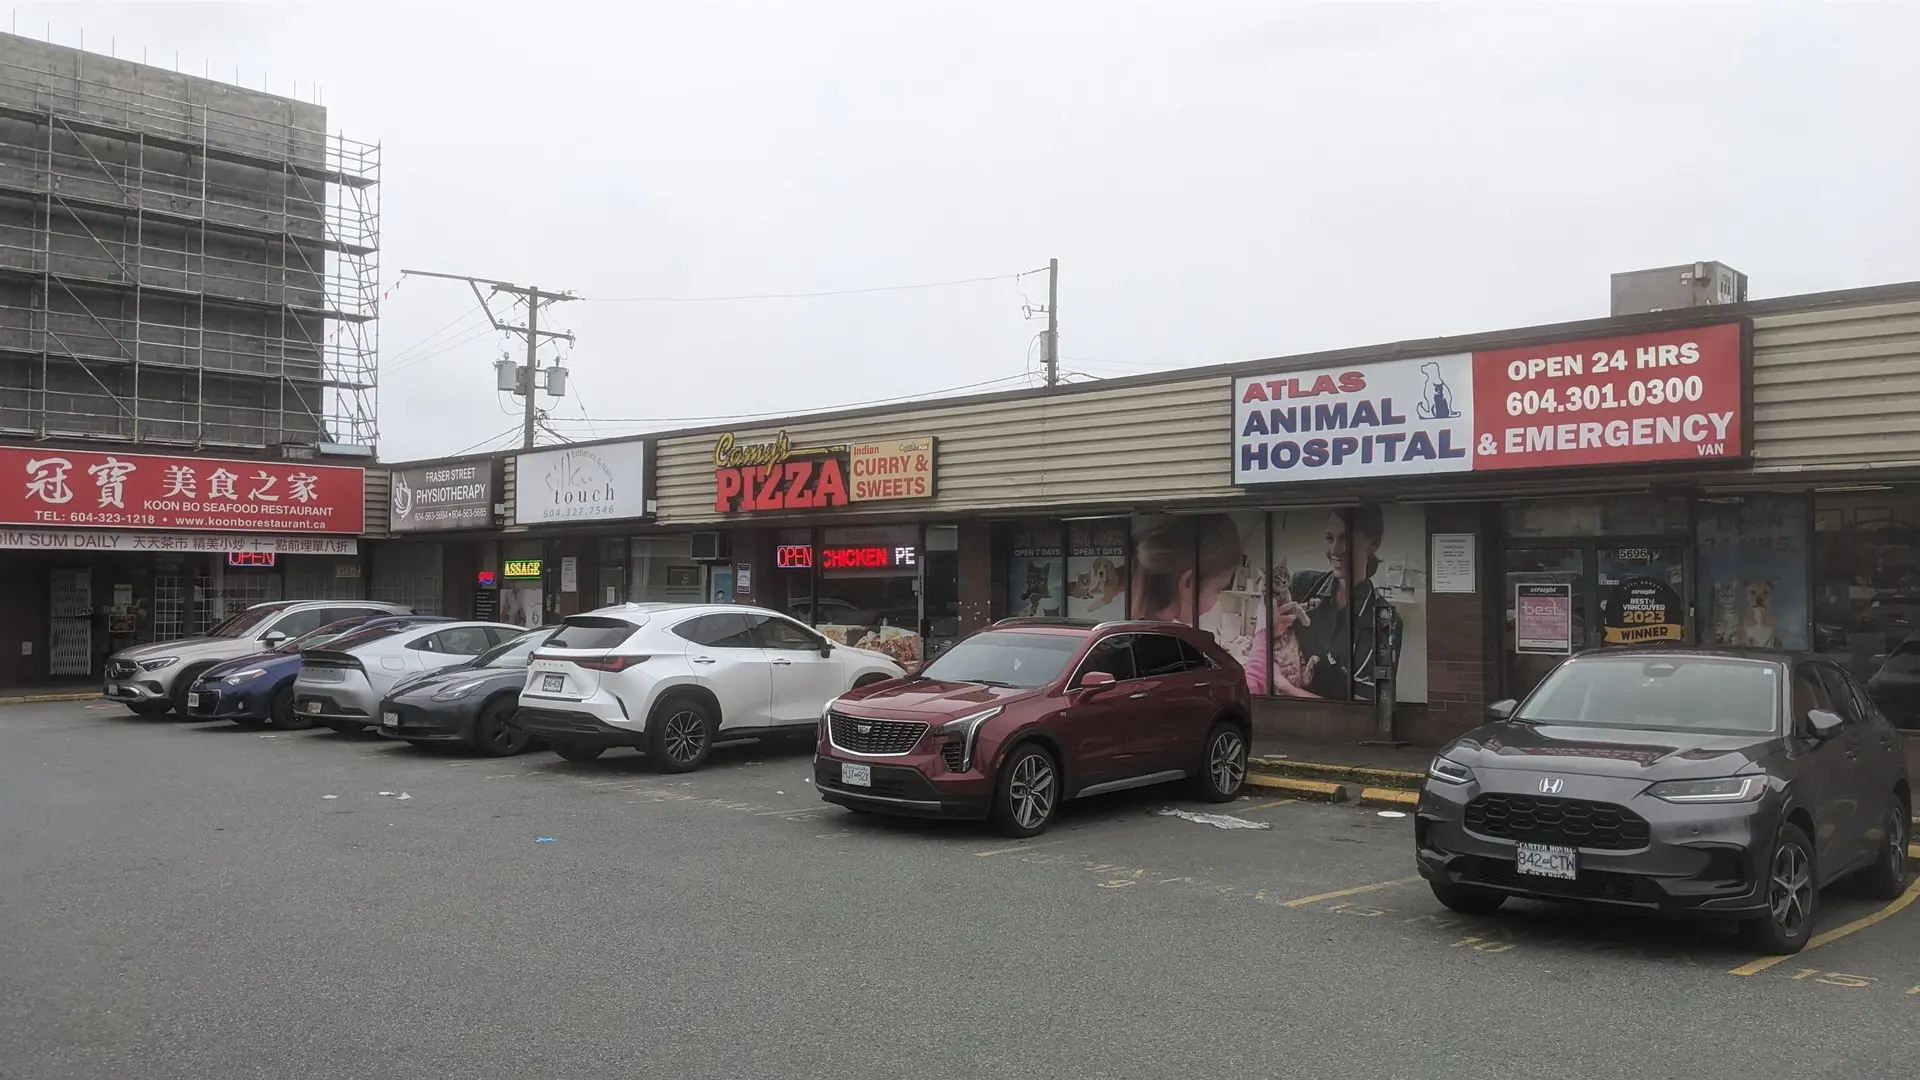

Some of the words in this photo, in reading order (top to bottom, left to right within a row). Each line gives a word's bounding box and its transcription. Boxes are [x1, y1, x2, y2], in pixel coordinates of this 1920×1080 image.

[1507, 354, 1583, 381] OPEN
[1591, 350, 1628, 373] 24
[1636, 342, 1700, 369] HRS
[1242, 371, 1367, 403] ATLAS
[1506, 375, 1703, 417] 604.301.0300
[1242, 397, 1407, 437] ANIMAL
[1477, 432, 1498, 456] &
[1504, 411, 1734, 454] EMERGENCY
[854, 445, 879, 456] Indian
[1241, 428, 1466, 471] HOSPITAL
[1697, 443, 1724, 456] VAN
[853, 455, 911, 476] CURRY
[914, 454, 928, 472] &
[25, 456, 137, 509] 冠寶
[162, 465, 319, 503] 美食之家
[426, 469, 450, 483] FRASER
[451, 467, 475, 481] STREET
[416, 484, 486, 504] PHYSIOTHERAPY
[554, 483, 615, 505] touch
[715, 458, 848, 512] PIZZA
[856, 476, 925, 498] SWEETS
[144, 500, 180, 511] KOON
[183, 502, 200, 512] BO
[203, 503, 258, 514] SEAFOOD
[261, 505, 333, 517] RESTAURANT
[543, 505, 614, 518] 604.327.7546
[35, 510, 66, 521] TEL:
[70, 512, 155, 524] 604-323-1218
[176, 516, 326, 529] www.koonborestaurant.ca
[29, 534, 68, 547] SUM
[74, 535, 120, 548] DAILY
[133, 536, 187, 549] 天天茶市
[193, 537, 245, 550] 精美小炒
[231, 552, 273, 564] OPEN
[778, 547, 812, 566] OPEN
[823, 548, 887, 568] CHICKEN
[1014, 548, 1034, 556] OPEN
[1035, 548, 1041, 556] 7
[1041, 548, 1061, 556] DAYS
[1073, 548, 1094, 556] OPEN
[1102, 547, 1123, 556] DAYS
[1620, 549, 1647, 559] 5696
[1522, 600, 1564, 616] best
[1623, 610, 1666, 624] 2023
[1621, 627, 1668, 640] WINNER
[1520, 842, 1547, 851] CARTER
[1549, 845, 1573, 854] HONDA
[1518, 851, 1542, 868] 842
[1549, 855, 1575, 871] CTW
